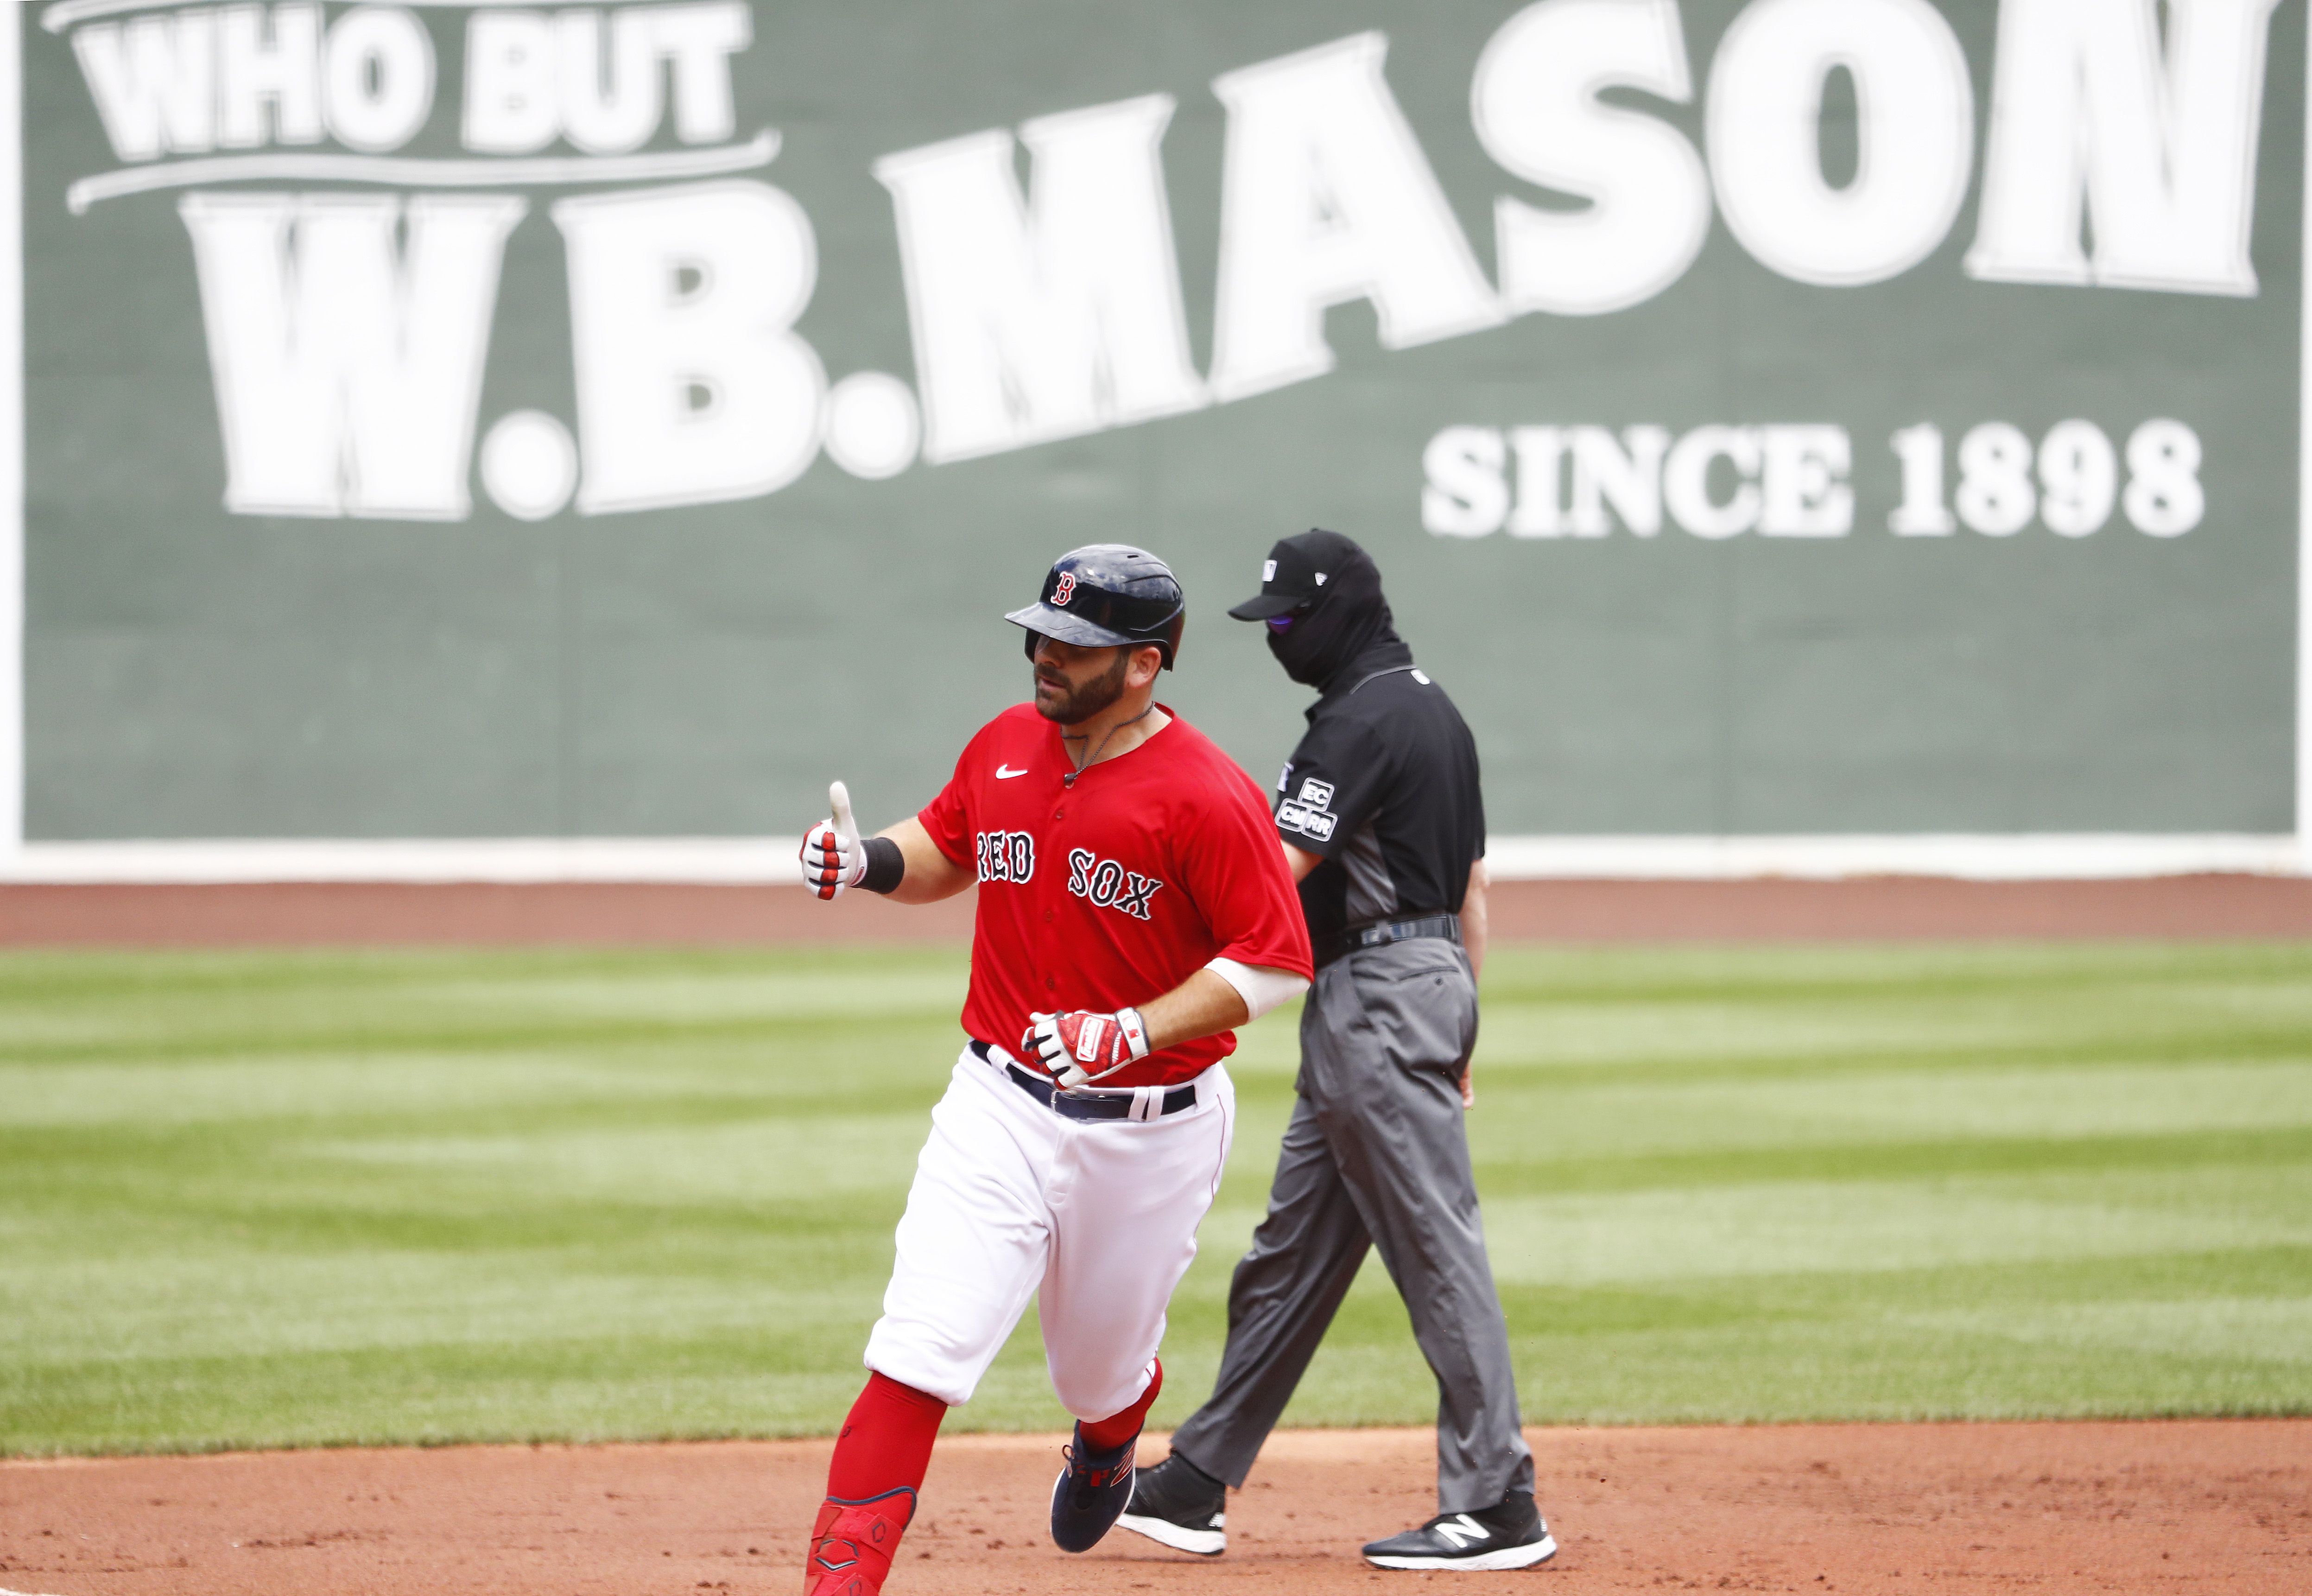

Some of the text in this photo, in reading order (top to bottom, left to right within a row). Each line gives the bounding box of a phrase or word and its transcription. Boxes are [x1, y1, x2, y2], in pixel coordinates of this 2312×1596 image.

[72, 2, 753, 161] WHO BUT
[1421, 419, 2205, 540] SINCE 1898
[1050, 570, 1077, 607] B
[1303, 784, 1329, 805] EC
[1306, 814, 1331, 835] RR
[1068, 848, 1164, 921] SOX
